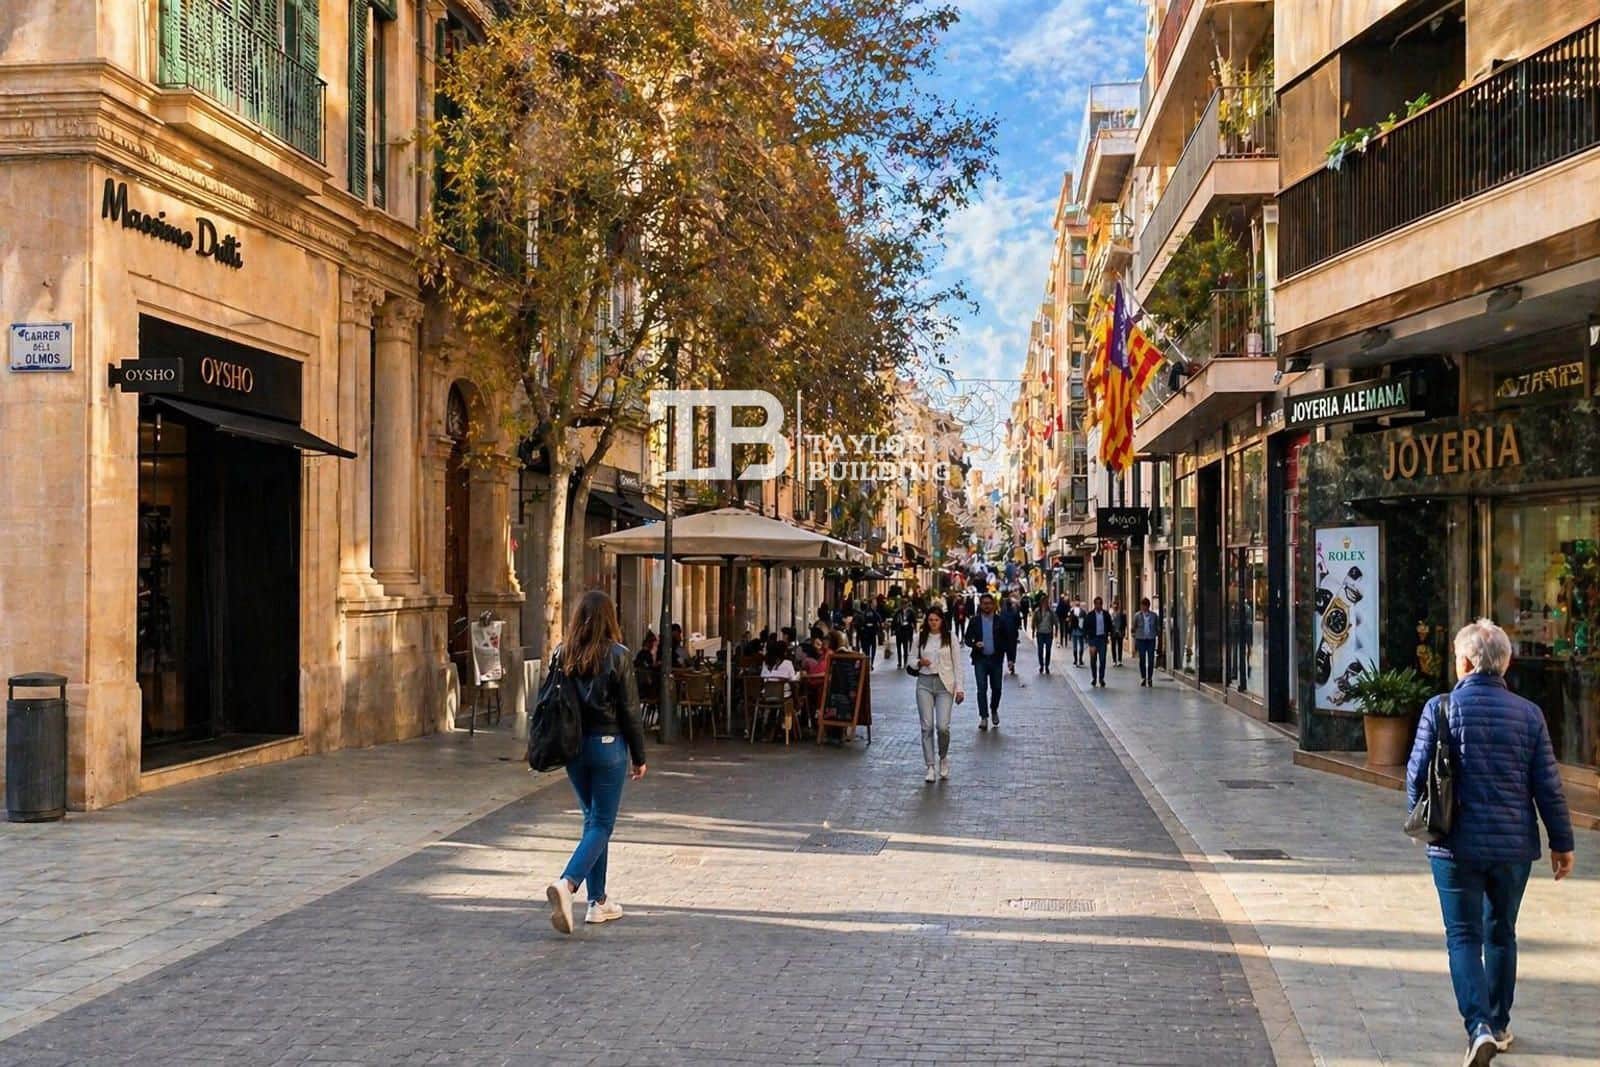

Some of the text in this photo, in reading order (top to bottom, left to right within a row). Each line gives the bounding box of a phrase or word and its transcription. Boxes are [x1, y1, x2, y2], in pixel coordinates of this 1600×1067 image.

[24, 330, 61, 342] CARRER
[25, 353, 61, 364] OLMOS
[125, 368, 175, 381] OYSHO
[201, 356, 254, 393] OYSHO
[1291, 395, 1340, 424] JOYERIA
[1342, 382, 1407, 415] ALEMANA
[1382, 423, 1522, 481] JOYERIA
[1327, 550, 1366, 561] ROLEX
